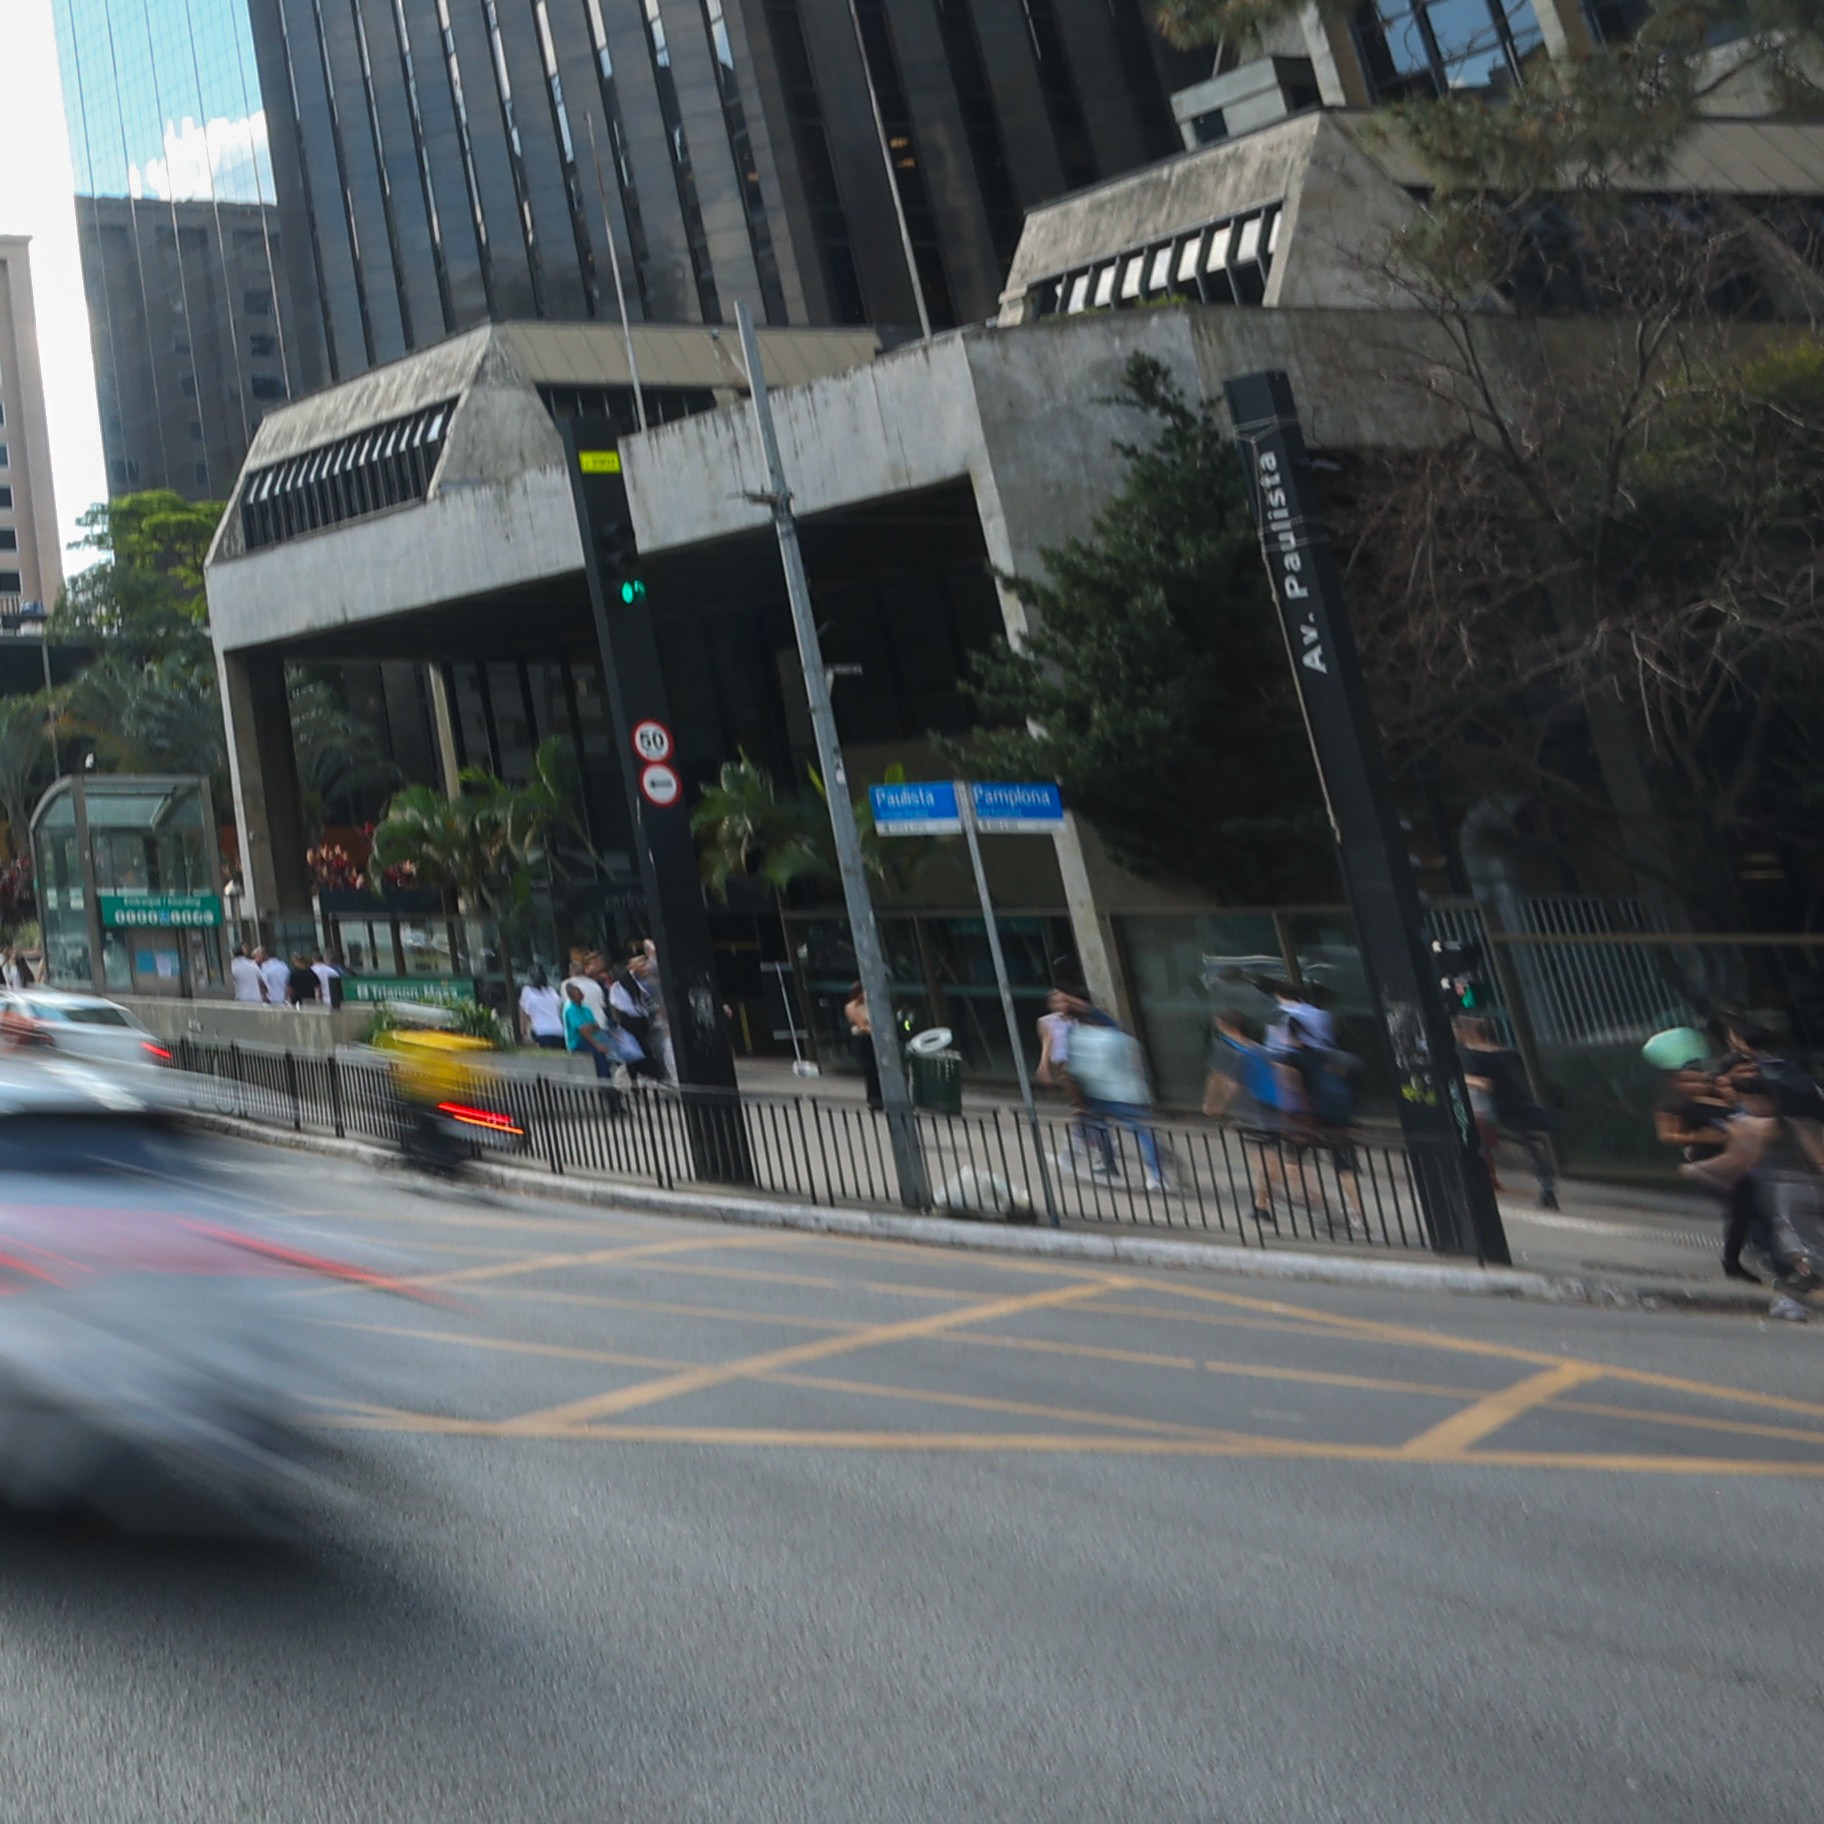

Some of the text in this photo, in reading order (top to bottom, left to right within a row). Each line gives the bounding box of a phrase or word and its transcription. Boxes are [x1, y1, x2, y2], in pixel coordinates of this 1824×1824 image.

[1259, 450, 1328, 674] Av. Paulista
[639, 729, 665, 752] 50
[875, 786, 936, 807] Paulista
[972, 784, 1051, 808] Pamplona
